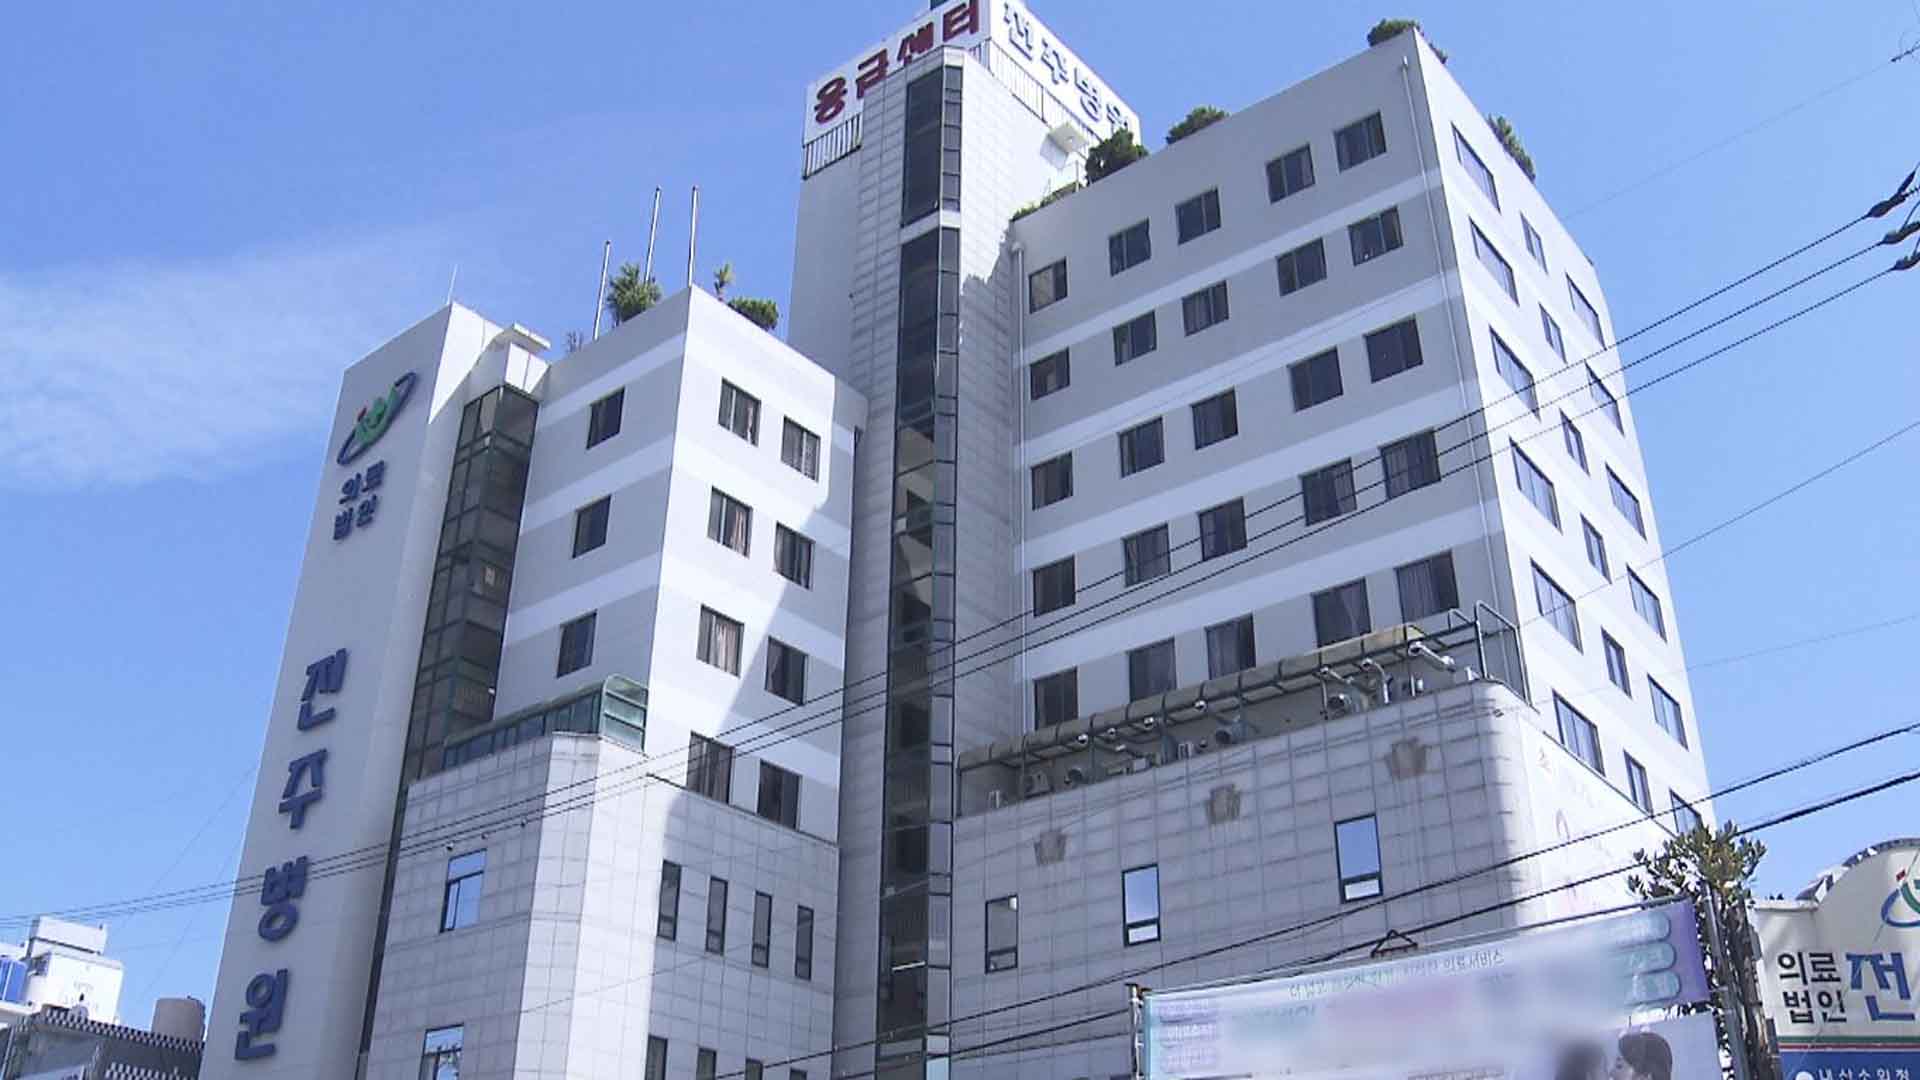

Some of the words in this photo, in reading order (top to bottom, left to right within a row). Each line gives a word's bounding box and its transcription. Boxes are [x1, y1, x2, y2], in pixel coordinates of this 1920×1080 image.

[813, 0, 979, 125] 응급센터
[338, 460, 386, 505] 의료
[332, 494, 378, 541] 법인
[234, 647, 349, 1061] 전주병원
[1777, 951, 1842, 986] 의료
[1846, 952, 1916, 1022] 전
[1784, 990, 1848, 1025] 법인
